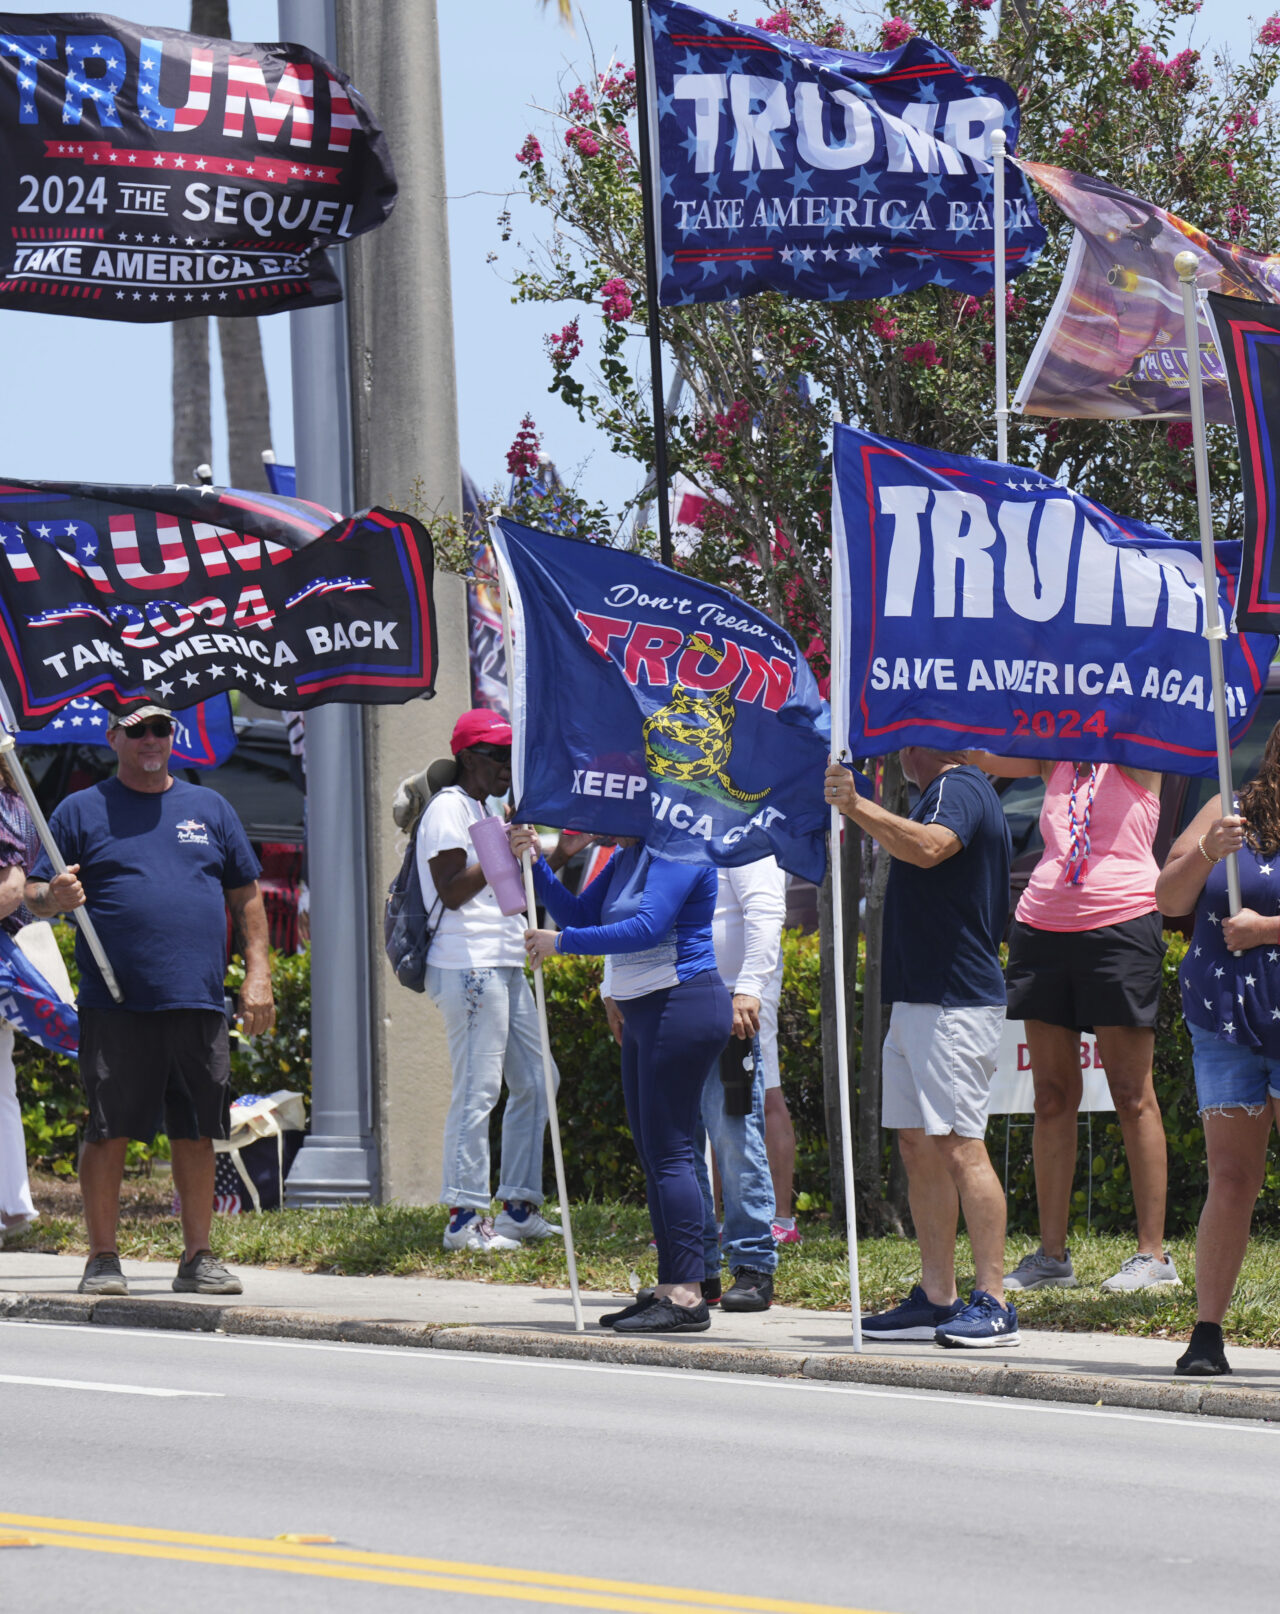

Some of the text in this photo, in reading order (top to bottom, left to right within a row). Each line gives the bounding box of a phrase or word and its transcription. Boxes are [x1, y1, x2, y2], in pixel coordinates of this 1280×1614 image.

[673, 73, 1005, 176] TRUMP
[17, 175, 357, 239] 2024 THE SEQUEL
[673, 198, 745, 231] TAKE
[750, 196, 936, 231] AMERICA
[12, 248, 82, 276] TAKE
[91, 252, 255, 282] AMERICA
[0, 512, 294, 594] TRUM
[603, 583, 692, 615] Don't
[43, 620, 400, 681] TAKE AMERICA BACK
[870, 656, 958, 692] SAVE
[966, 659, 1134, 697] AMERICA
[1012, 708, 1110, 739] 2024
